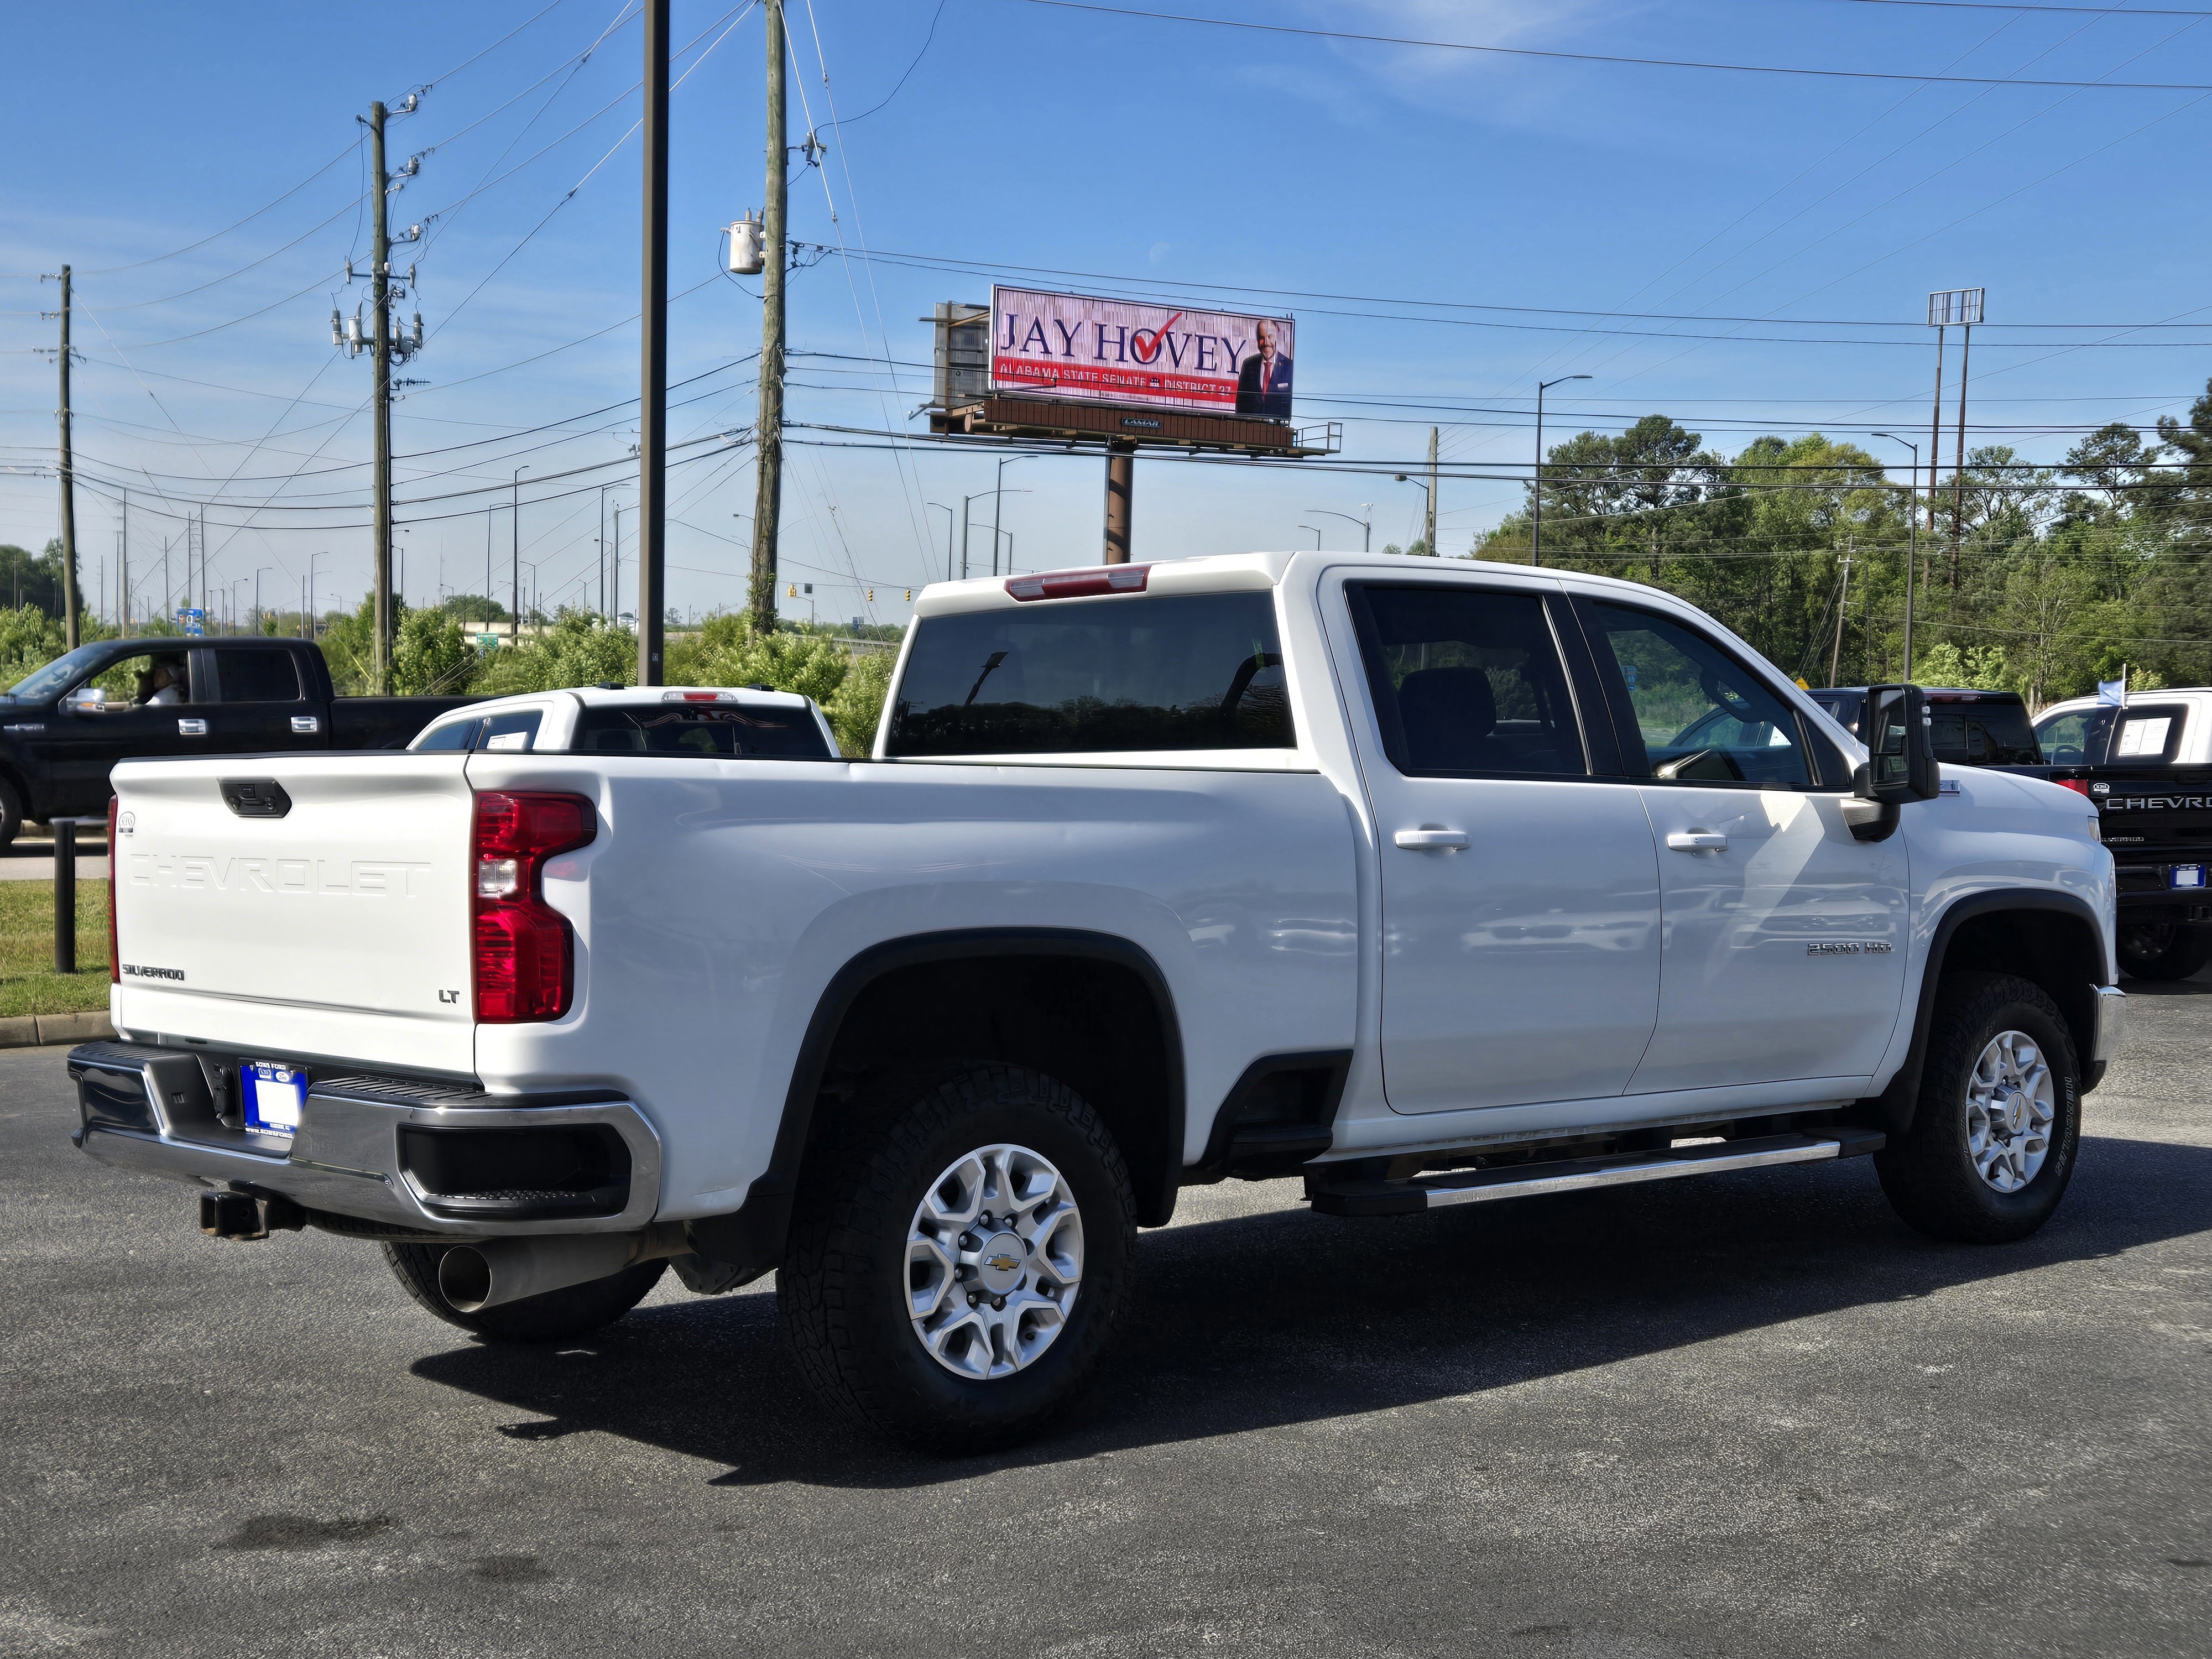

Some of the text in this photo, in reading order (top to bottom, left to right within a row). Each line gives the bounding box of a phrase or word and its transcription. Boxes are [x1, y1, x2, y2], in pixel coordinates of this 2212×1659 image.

[1000, 313, 1247, 374] JAY HOVEY
[1000, 363, 1059, 378] ALABAMA
[1063, 369, 1098, 382] STATE
[1102, 373, 1146, 387] SENATE
[1164, 379, 1216, 393] DISTRICT
[130, 854, 431, 898] CHEVROLET
[1808, 942, 1892, 956] 2500 HD
[122, 964, 185, 981] SILVERADO
[439, 989, 460, 1004] LT
